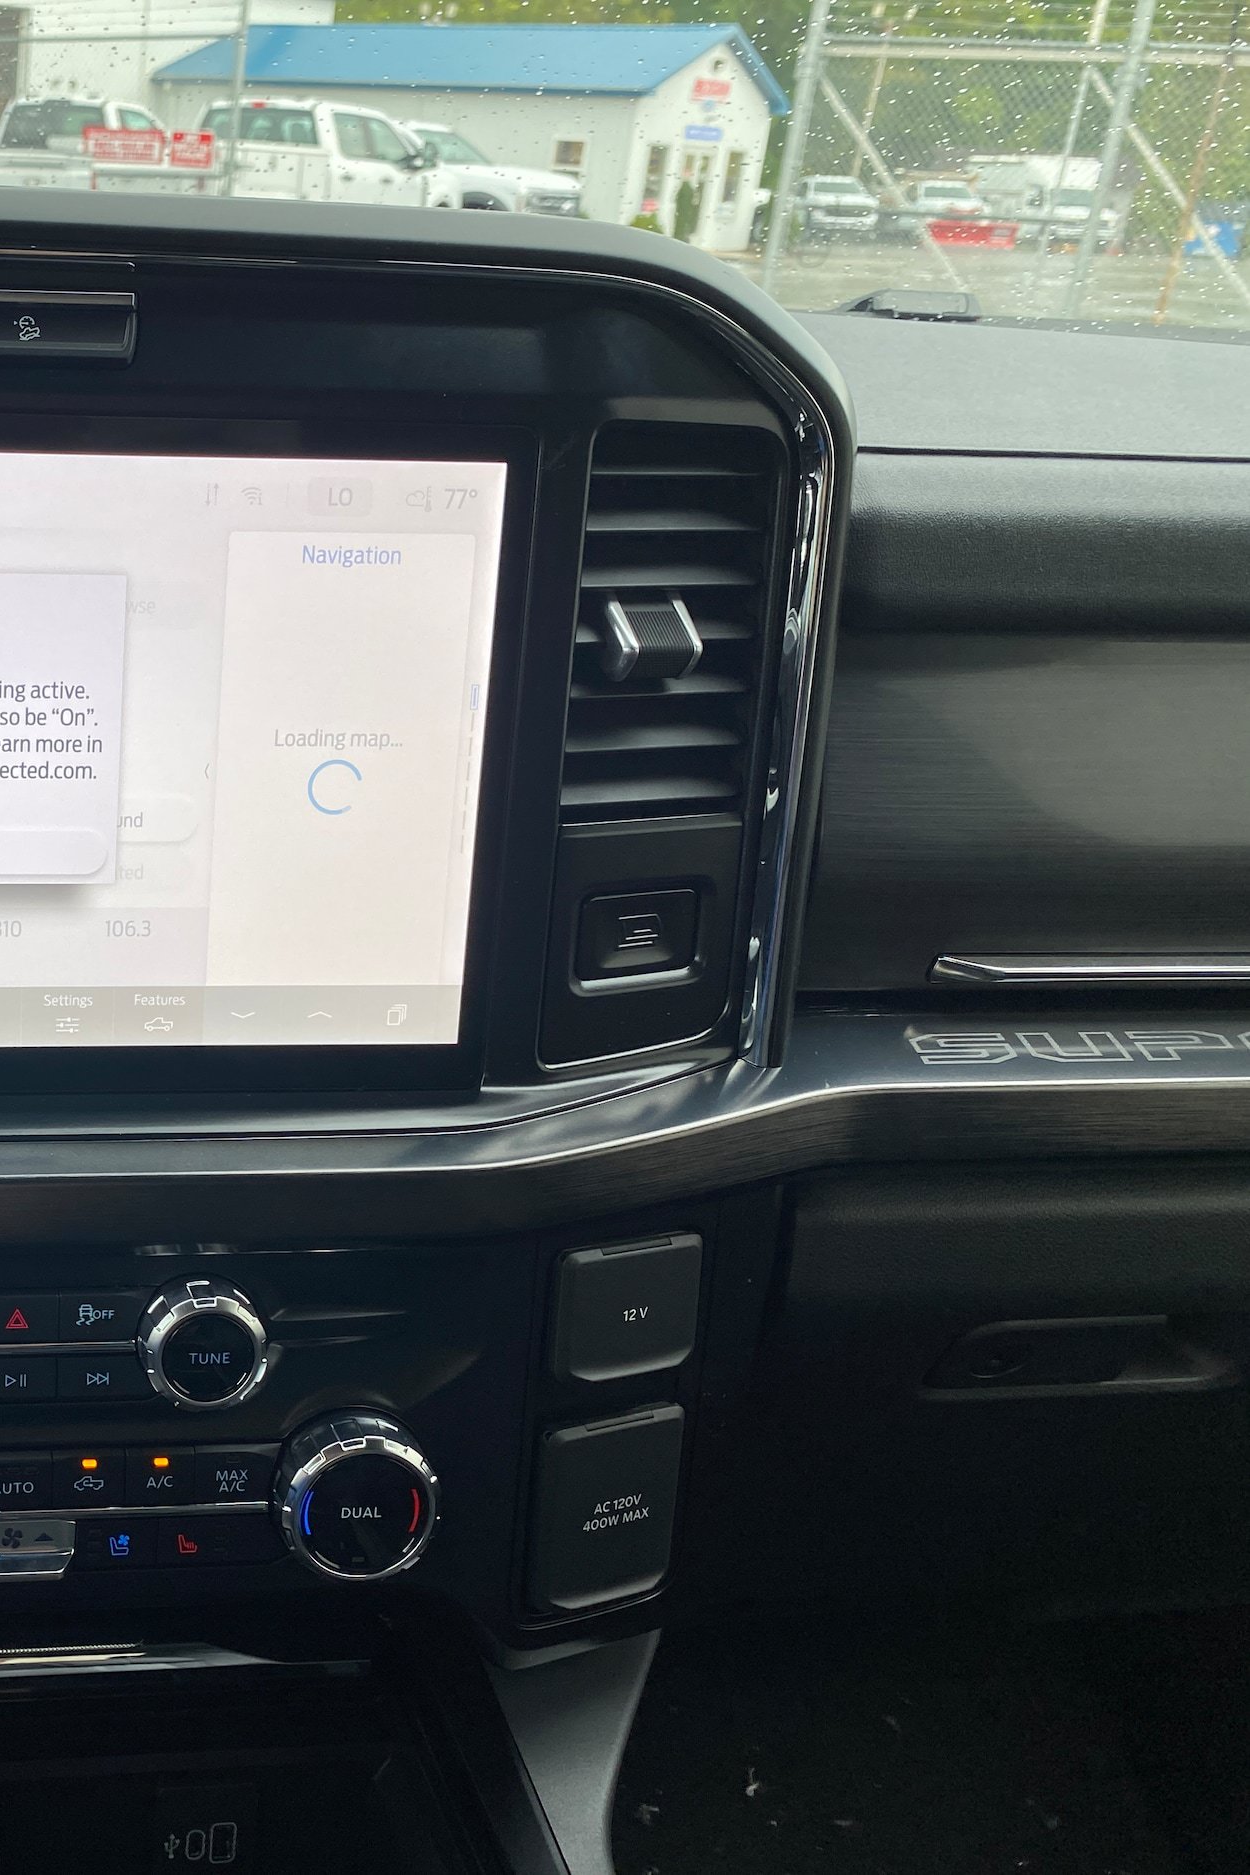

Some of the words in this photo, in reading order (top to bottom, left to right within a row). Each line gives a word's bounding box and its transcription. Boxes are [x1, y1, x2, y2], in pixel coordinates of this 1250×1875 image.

[328, 487, 352, 506] LO
[302, 546, 401, 567] Navigation
[126, 598, 156, 613] wse
[31, 682, 89, 700] active.
[26, 708, 45, 726] be
[36, 738, 82, 753] more
[87, 735, 103, 752] in
[275, 729, 346, 751] Loading
[351, 733, 403, 752] map...
[117, 812, 143, 828] und
[118, 865, 143, 881] ted
[105, 920, 151, 938] 106.3
[43, 994, 93, 1008] Settings
[134, 994, 185, 1007] Features
[909, 1030, 1250, 1065] SUP
[93, 1309, 114, 1320] OFF
[623, 1308, 637, 1322] 12
[639, 1307, 649, 1319] V
[189, 1352, 231, 1365] TUNE
[146, 1476, 173, 1489] A/C
[216, 1470, 248, 1482] MAX
[219, 1480, 246, 1492] A/C
[594, 1501, 611, 1515] AC
[613, 1493, 643, 1510] 120V
[341, 1506, 382, 1519] DUAL
[583, 1515, 619, 1532] 400W
[622, 1507, 650, 1523] MAX
